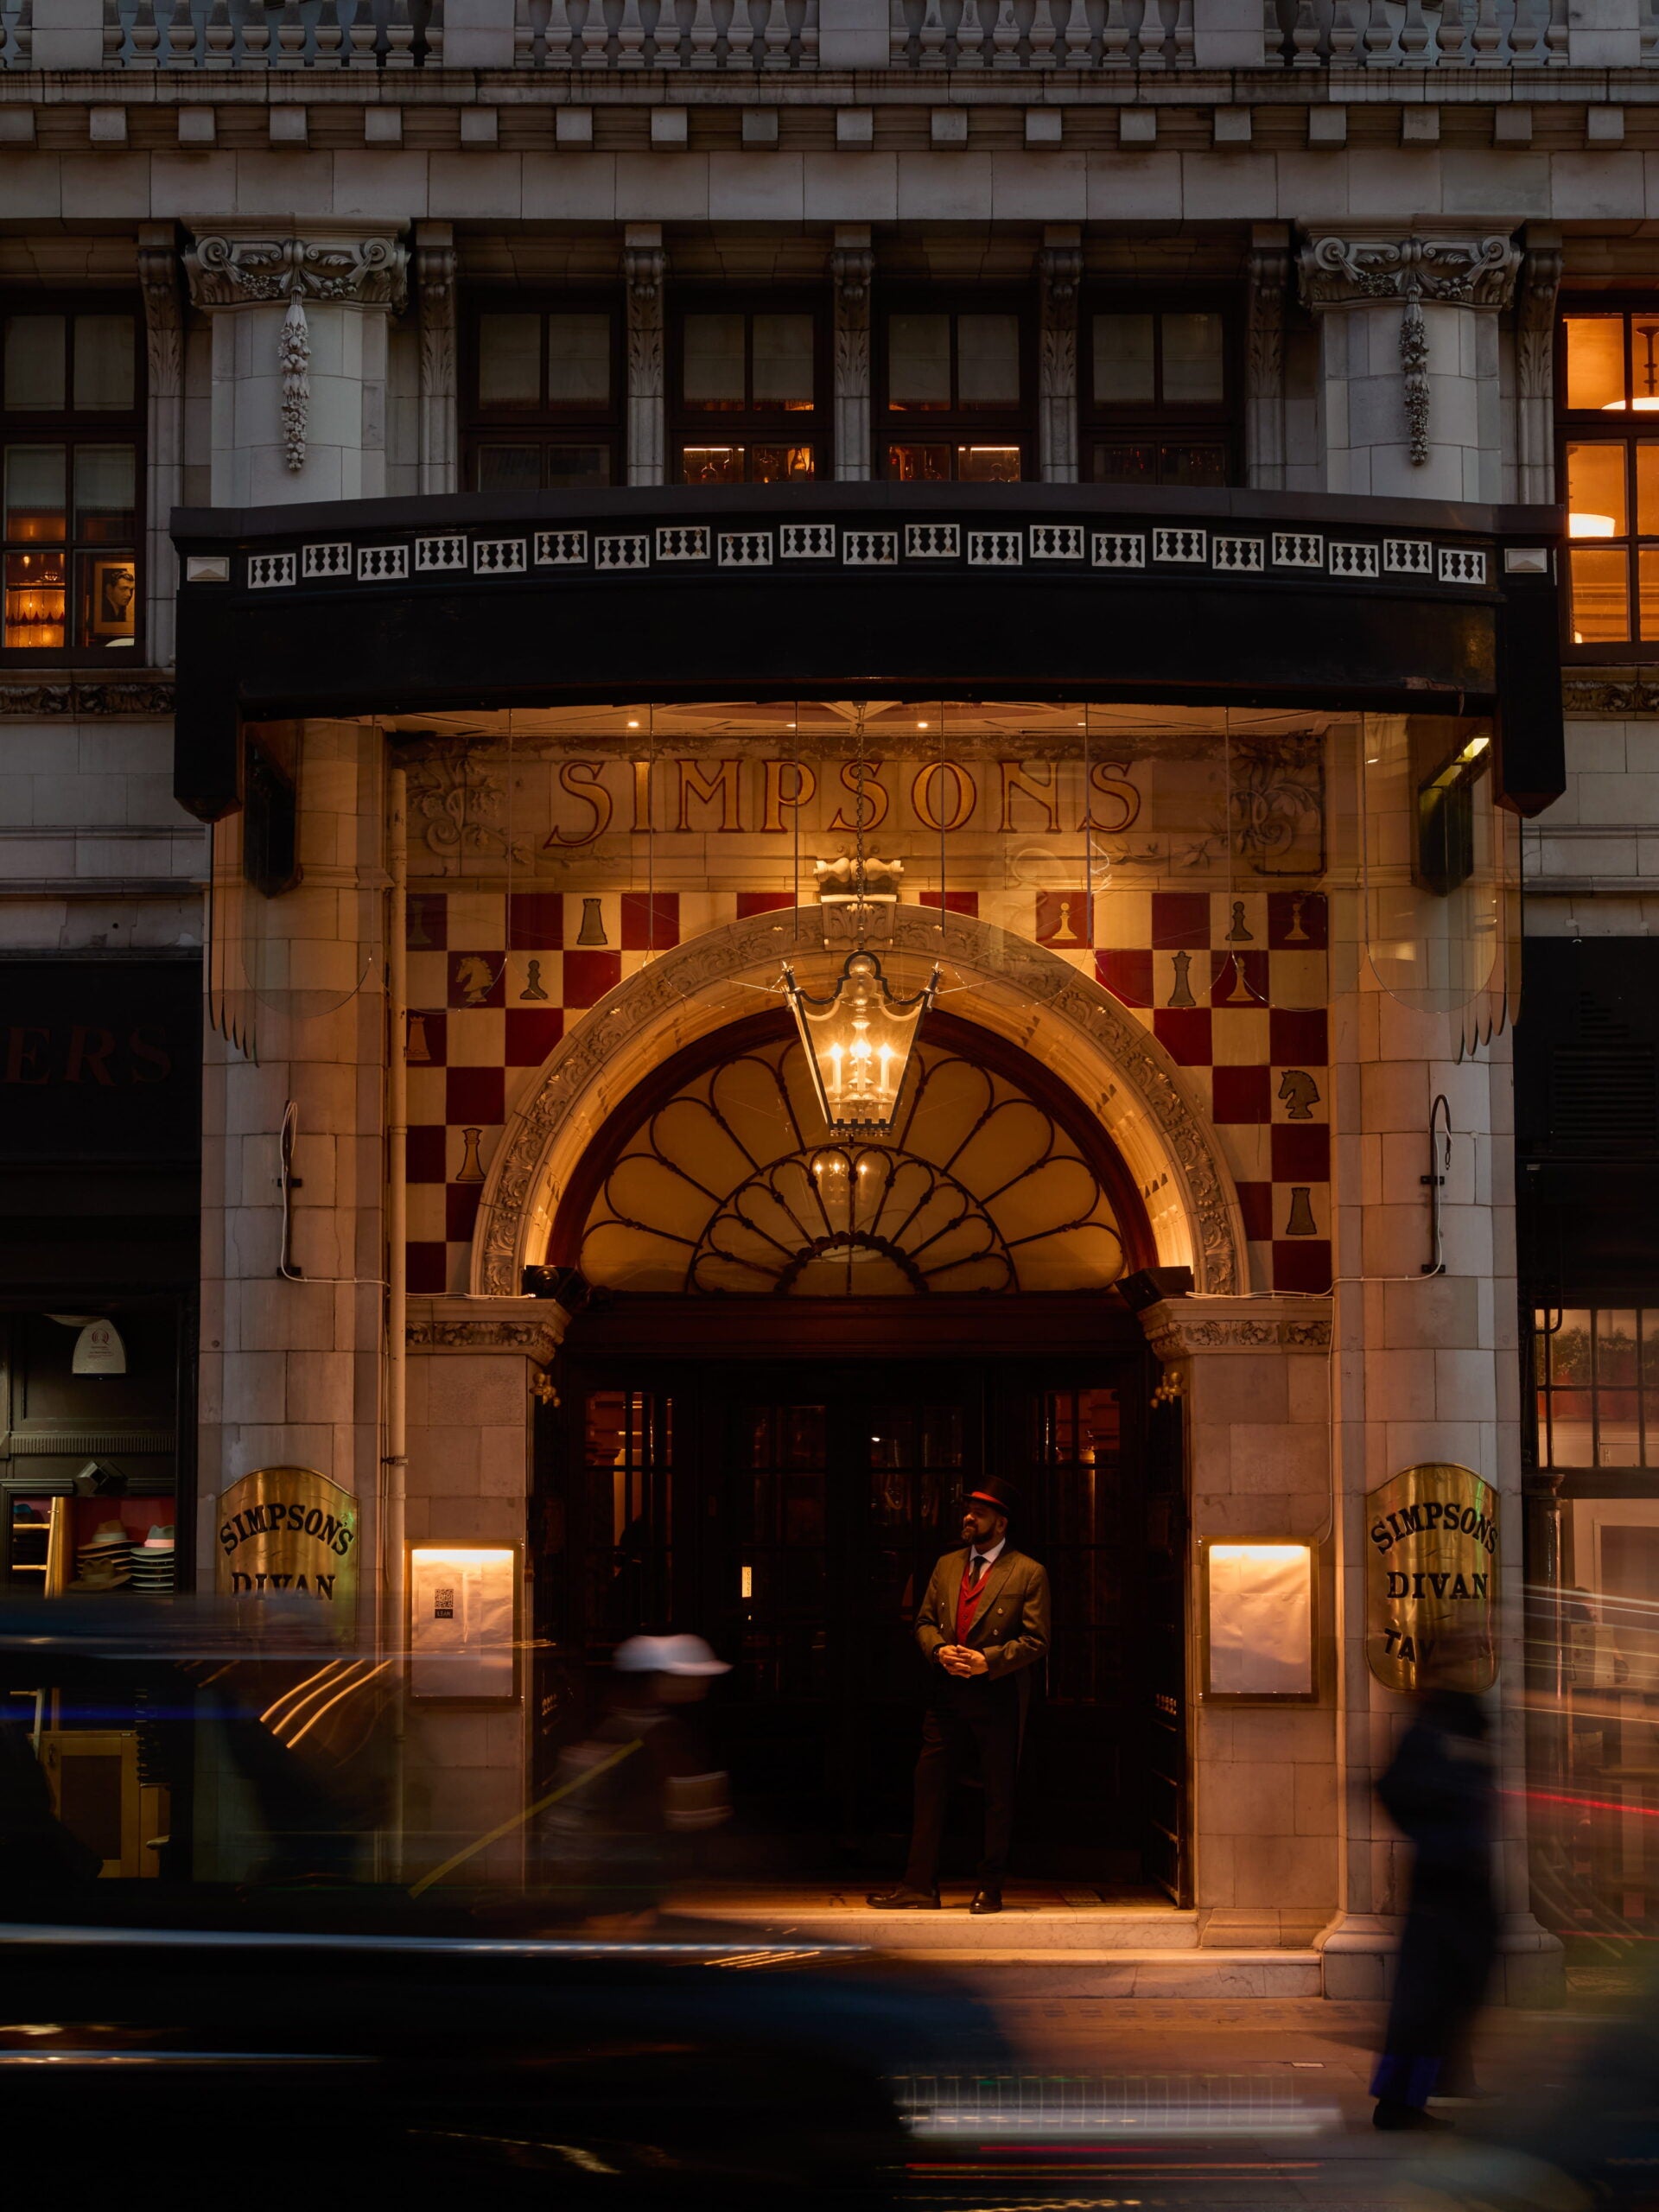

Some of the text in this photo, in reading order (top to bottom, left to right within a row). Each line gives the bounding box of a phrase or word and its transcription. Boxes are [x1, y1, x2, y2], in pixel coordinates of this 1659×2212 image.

[543, 759, 1141, 849] SIMPSONS
[0, 1023, 172, 1087] ERS
[232, 1572, 336, 1600] DIVAN
[1387, 1571, 1488, 1599] DIVAN
